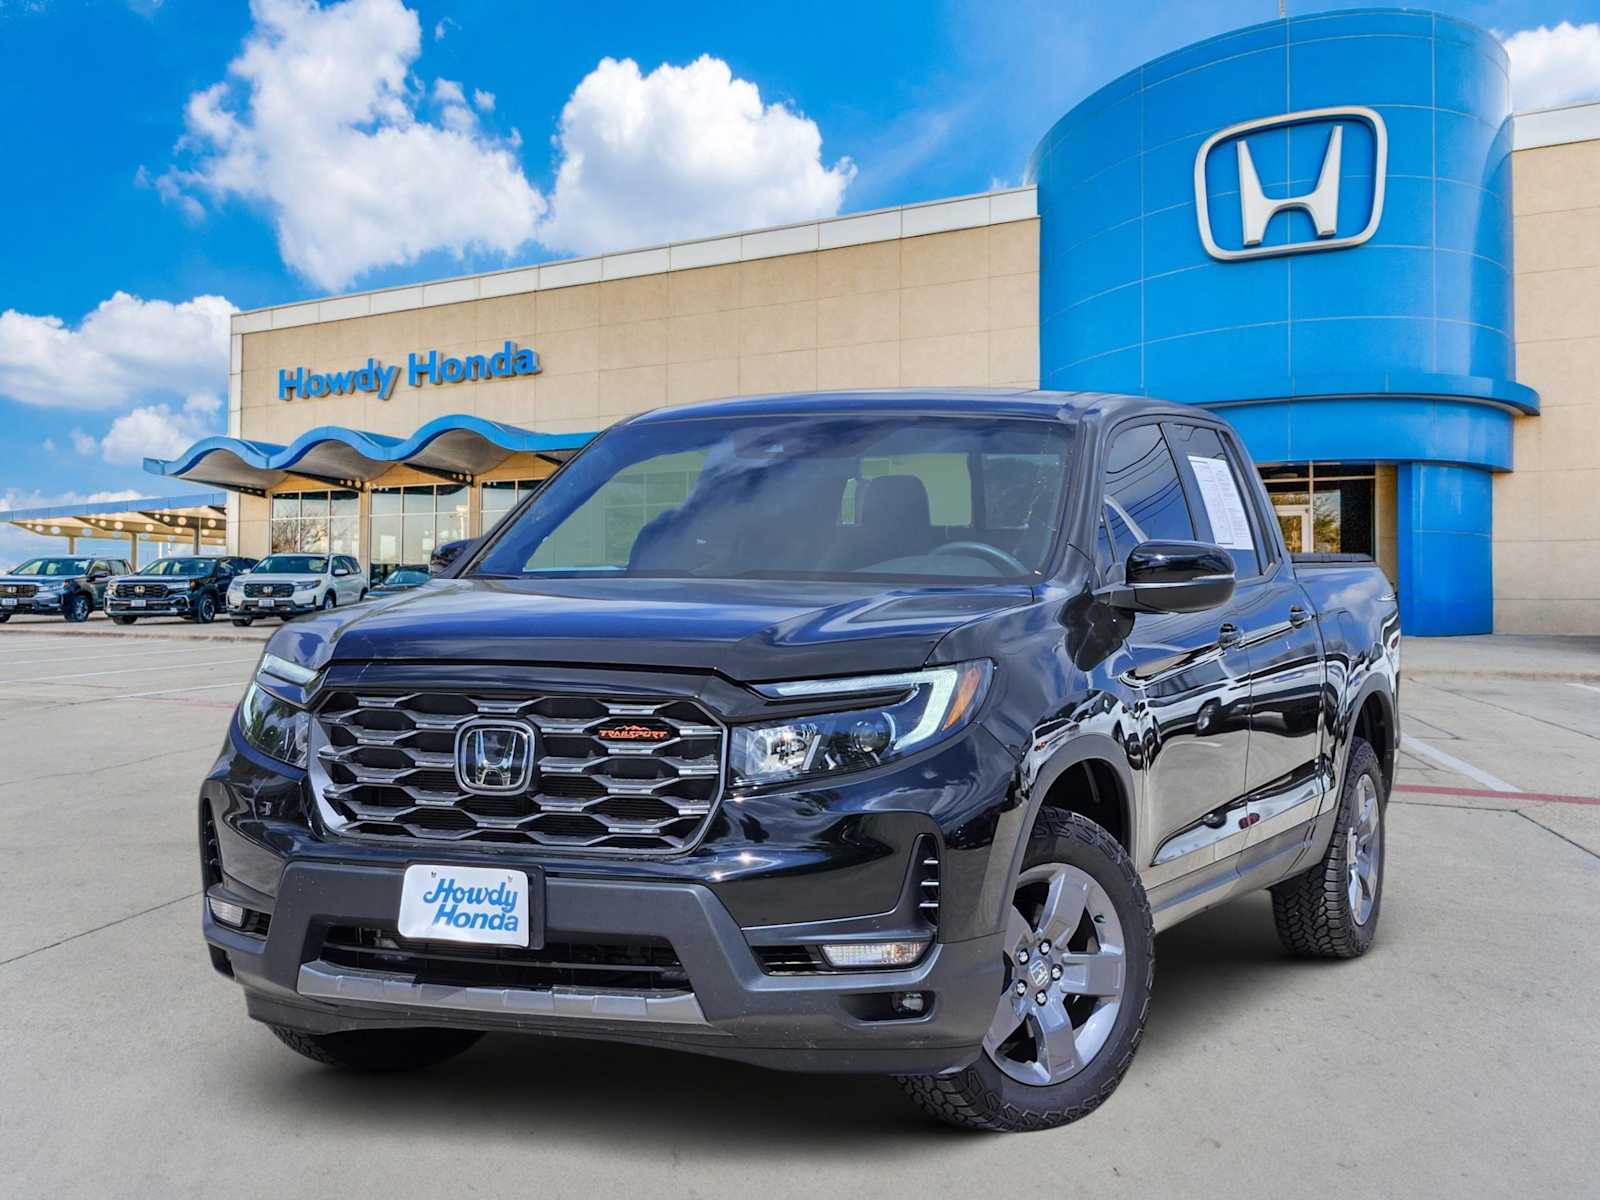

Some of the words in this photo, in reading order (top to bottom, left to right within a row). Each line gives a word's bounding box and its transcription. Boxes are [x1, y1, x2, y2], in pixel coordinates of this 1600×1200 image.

[278, 358, 400, 400] Howdy
[408, 340, 542, 387] Honda
[423, 878, 518, 913] Howdy
[432, 903, 519, 932] Honda
